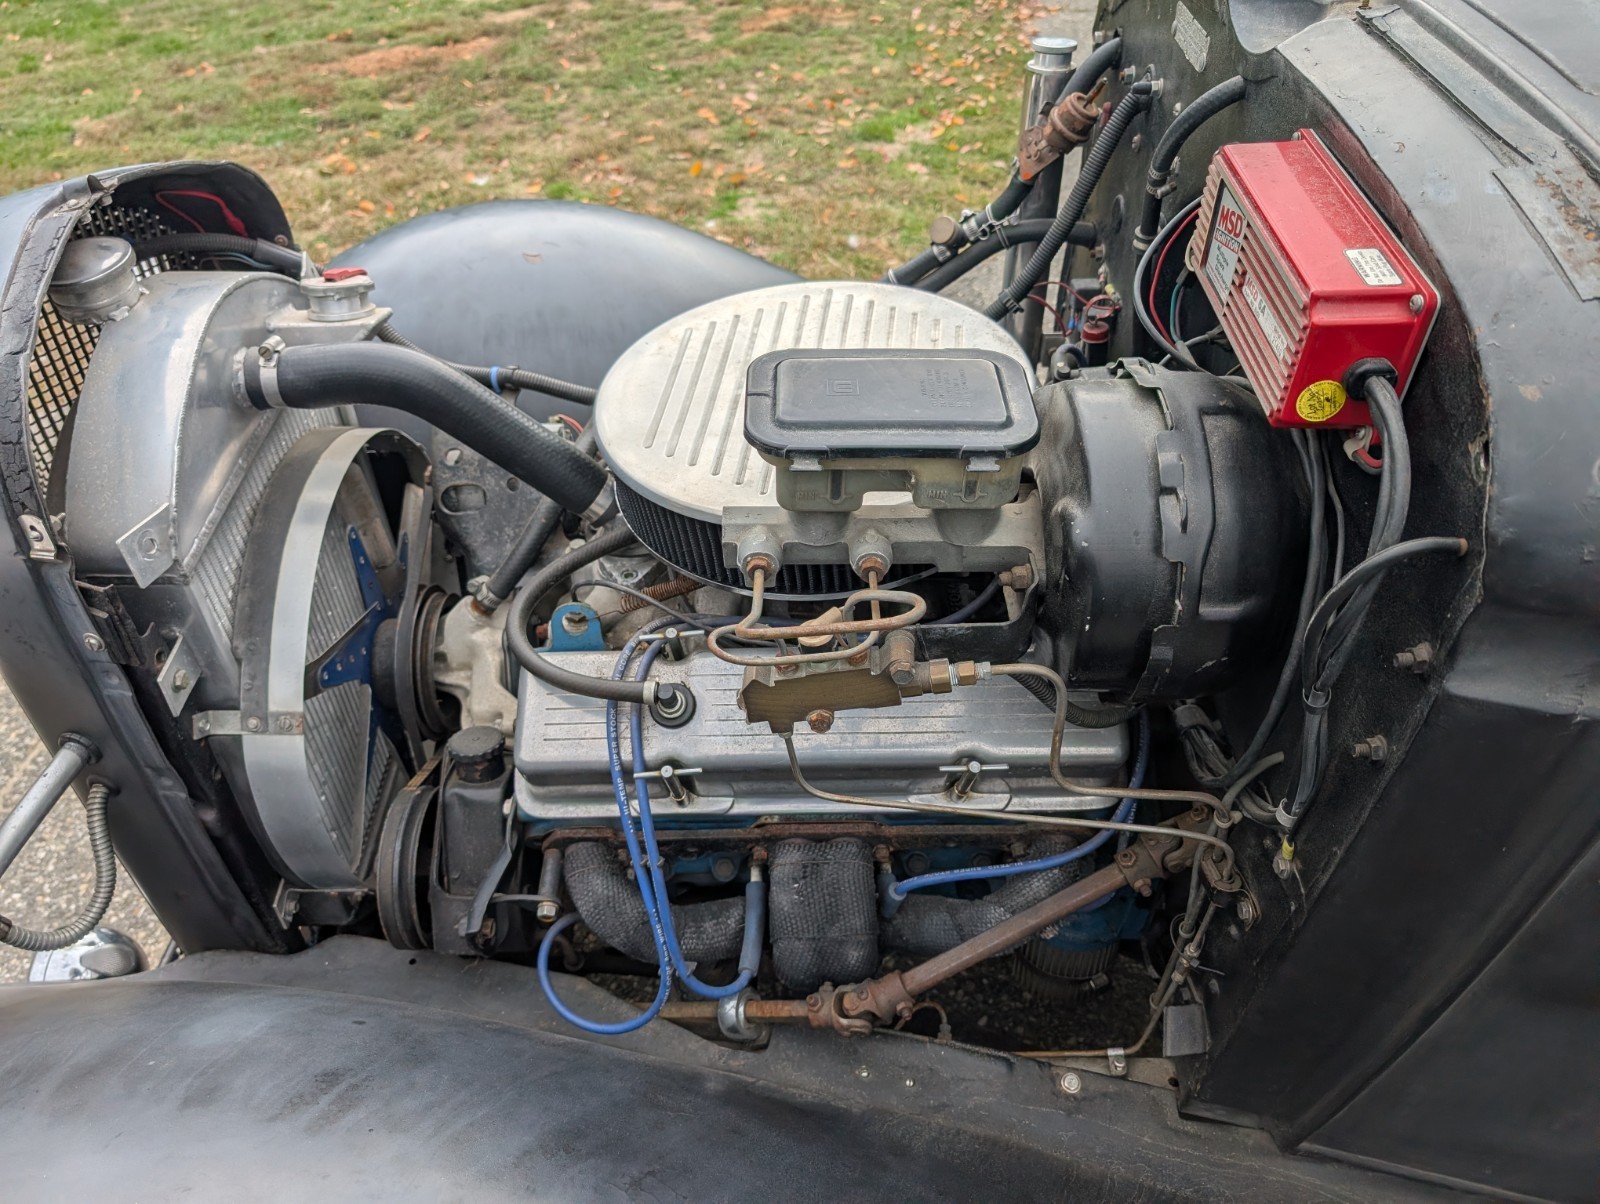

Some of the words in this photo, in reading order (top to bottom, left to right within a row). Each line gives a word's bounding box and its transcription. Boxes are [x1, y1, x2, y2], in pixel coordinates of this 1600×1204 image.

[1218, 205, 1243, 238] MSD
[1214, 228, 1241, 254] IGNITION
[1246, 277, 1259, 301] MSD
[1258, 298, 1267, 316] 6A
[927, 489, 948, 499] MIN
[645, 620, 661, 633] WIRE
[618, 649, 630, 670] CORE
[610, 708, 618, 738] STOCK
[611, 741, 622, 771] SUPER
[617, 777, 631, 815] HI-TEMP
[655, 923, 666, 943] WIRE
